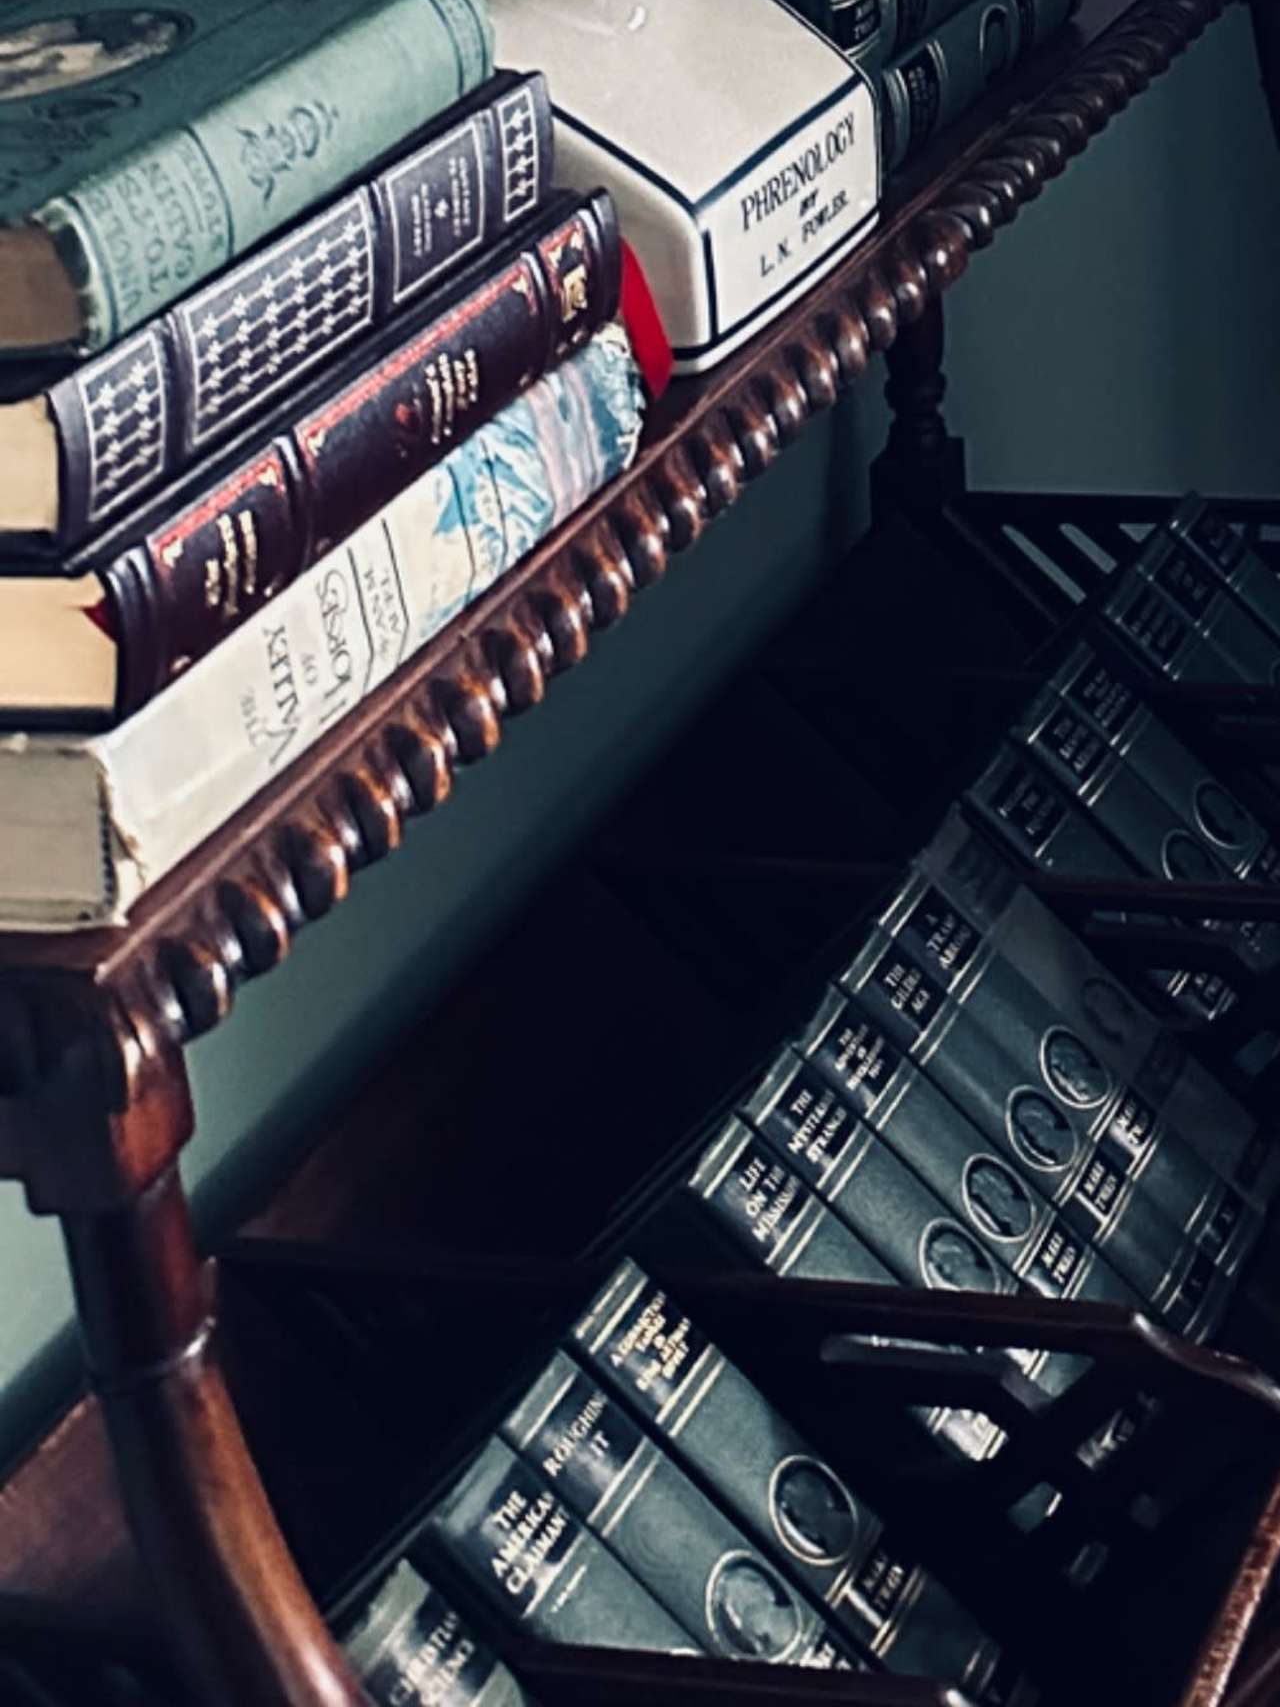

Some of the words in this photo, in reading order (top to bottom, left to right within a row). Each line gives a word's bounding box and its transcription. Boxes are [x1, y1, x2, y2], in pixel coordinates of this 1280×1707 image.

[801, 190, 850, 243] FOWLER
[315, 568, 352, 726] HORSES
[299, 651, 320, 687] OF
[262, 623, 299, 768] VALLEY
[239, 685, 262, 749] THE
[885, 963, 906, 992] THE
[787, 1087, 814, 1121] THE
[740, 1152, 769, 1193] LIFE
[742, 1192, 767, 1220] ON
[590, 1430, 611, 1457] IT
[493, 1489, 527, 1531] THE
